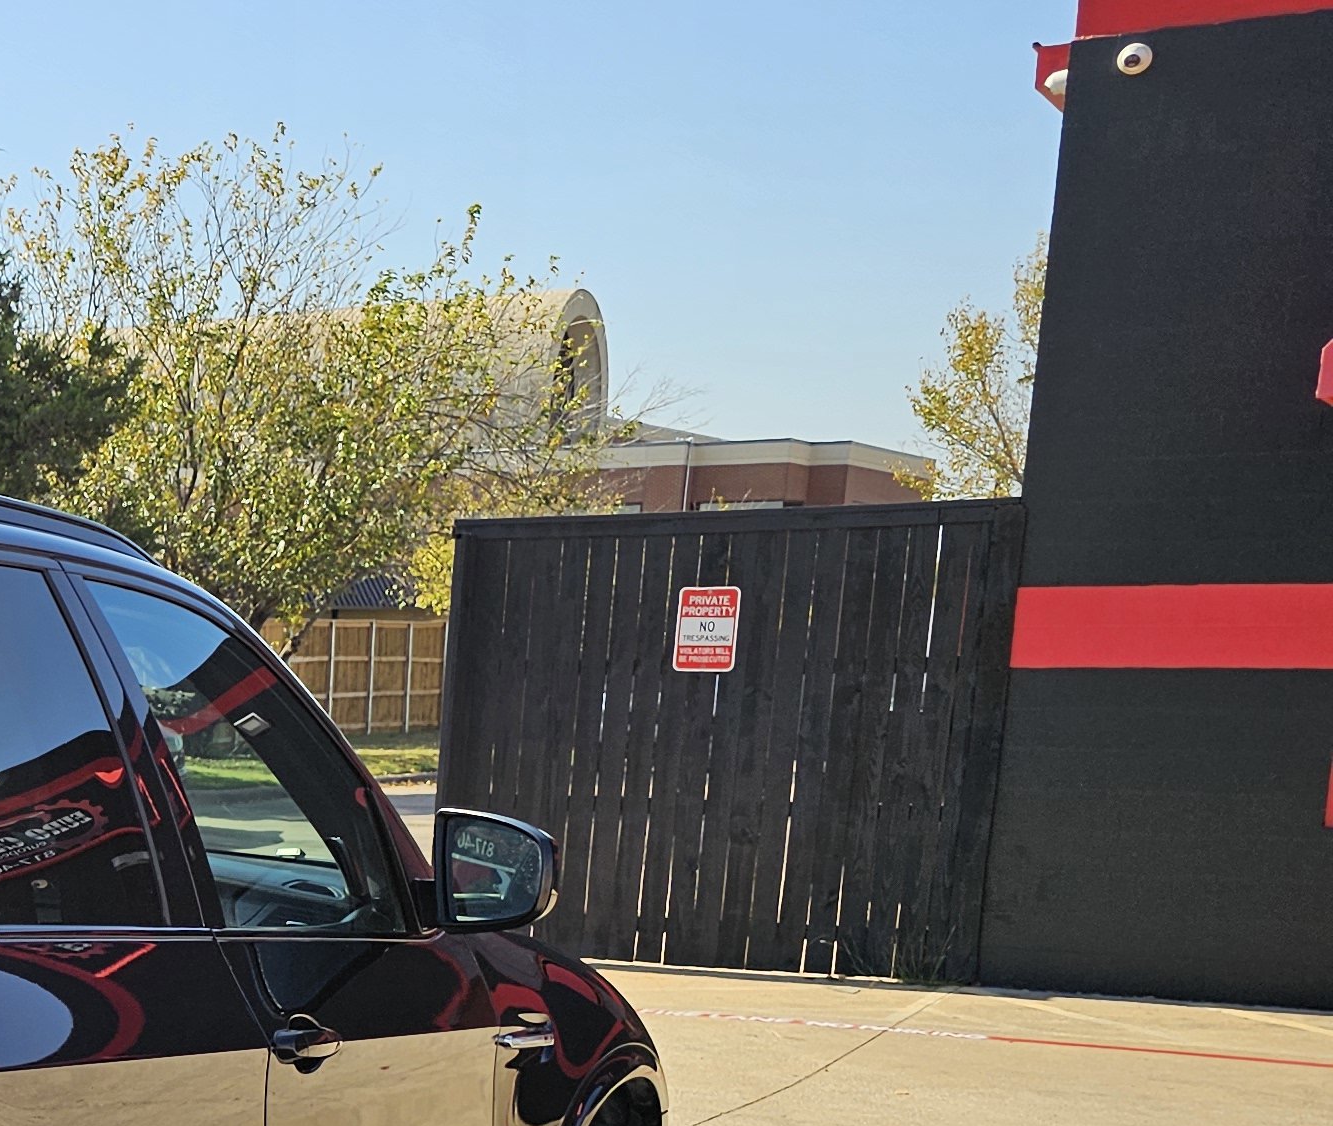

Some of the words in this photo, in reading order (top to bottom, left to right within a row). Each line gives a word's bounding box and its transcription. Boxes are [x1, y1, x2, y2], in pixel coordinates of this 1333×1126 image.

[689, 595, 731, 605] PRIVATE
[682, 606, 735, 616] PROPERTY
[699, 621, 715, 632] NO
[715, 647, 731, 655] WILL
[678, 655, 687, 663] BE
